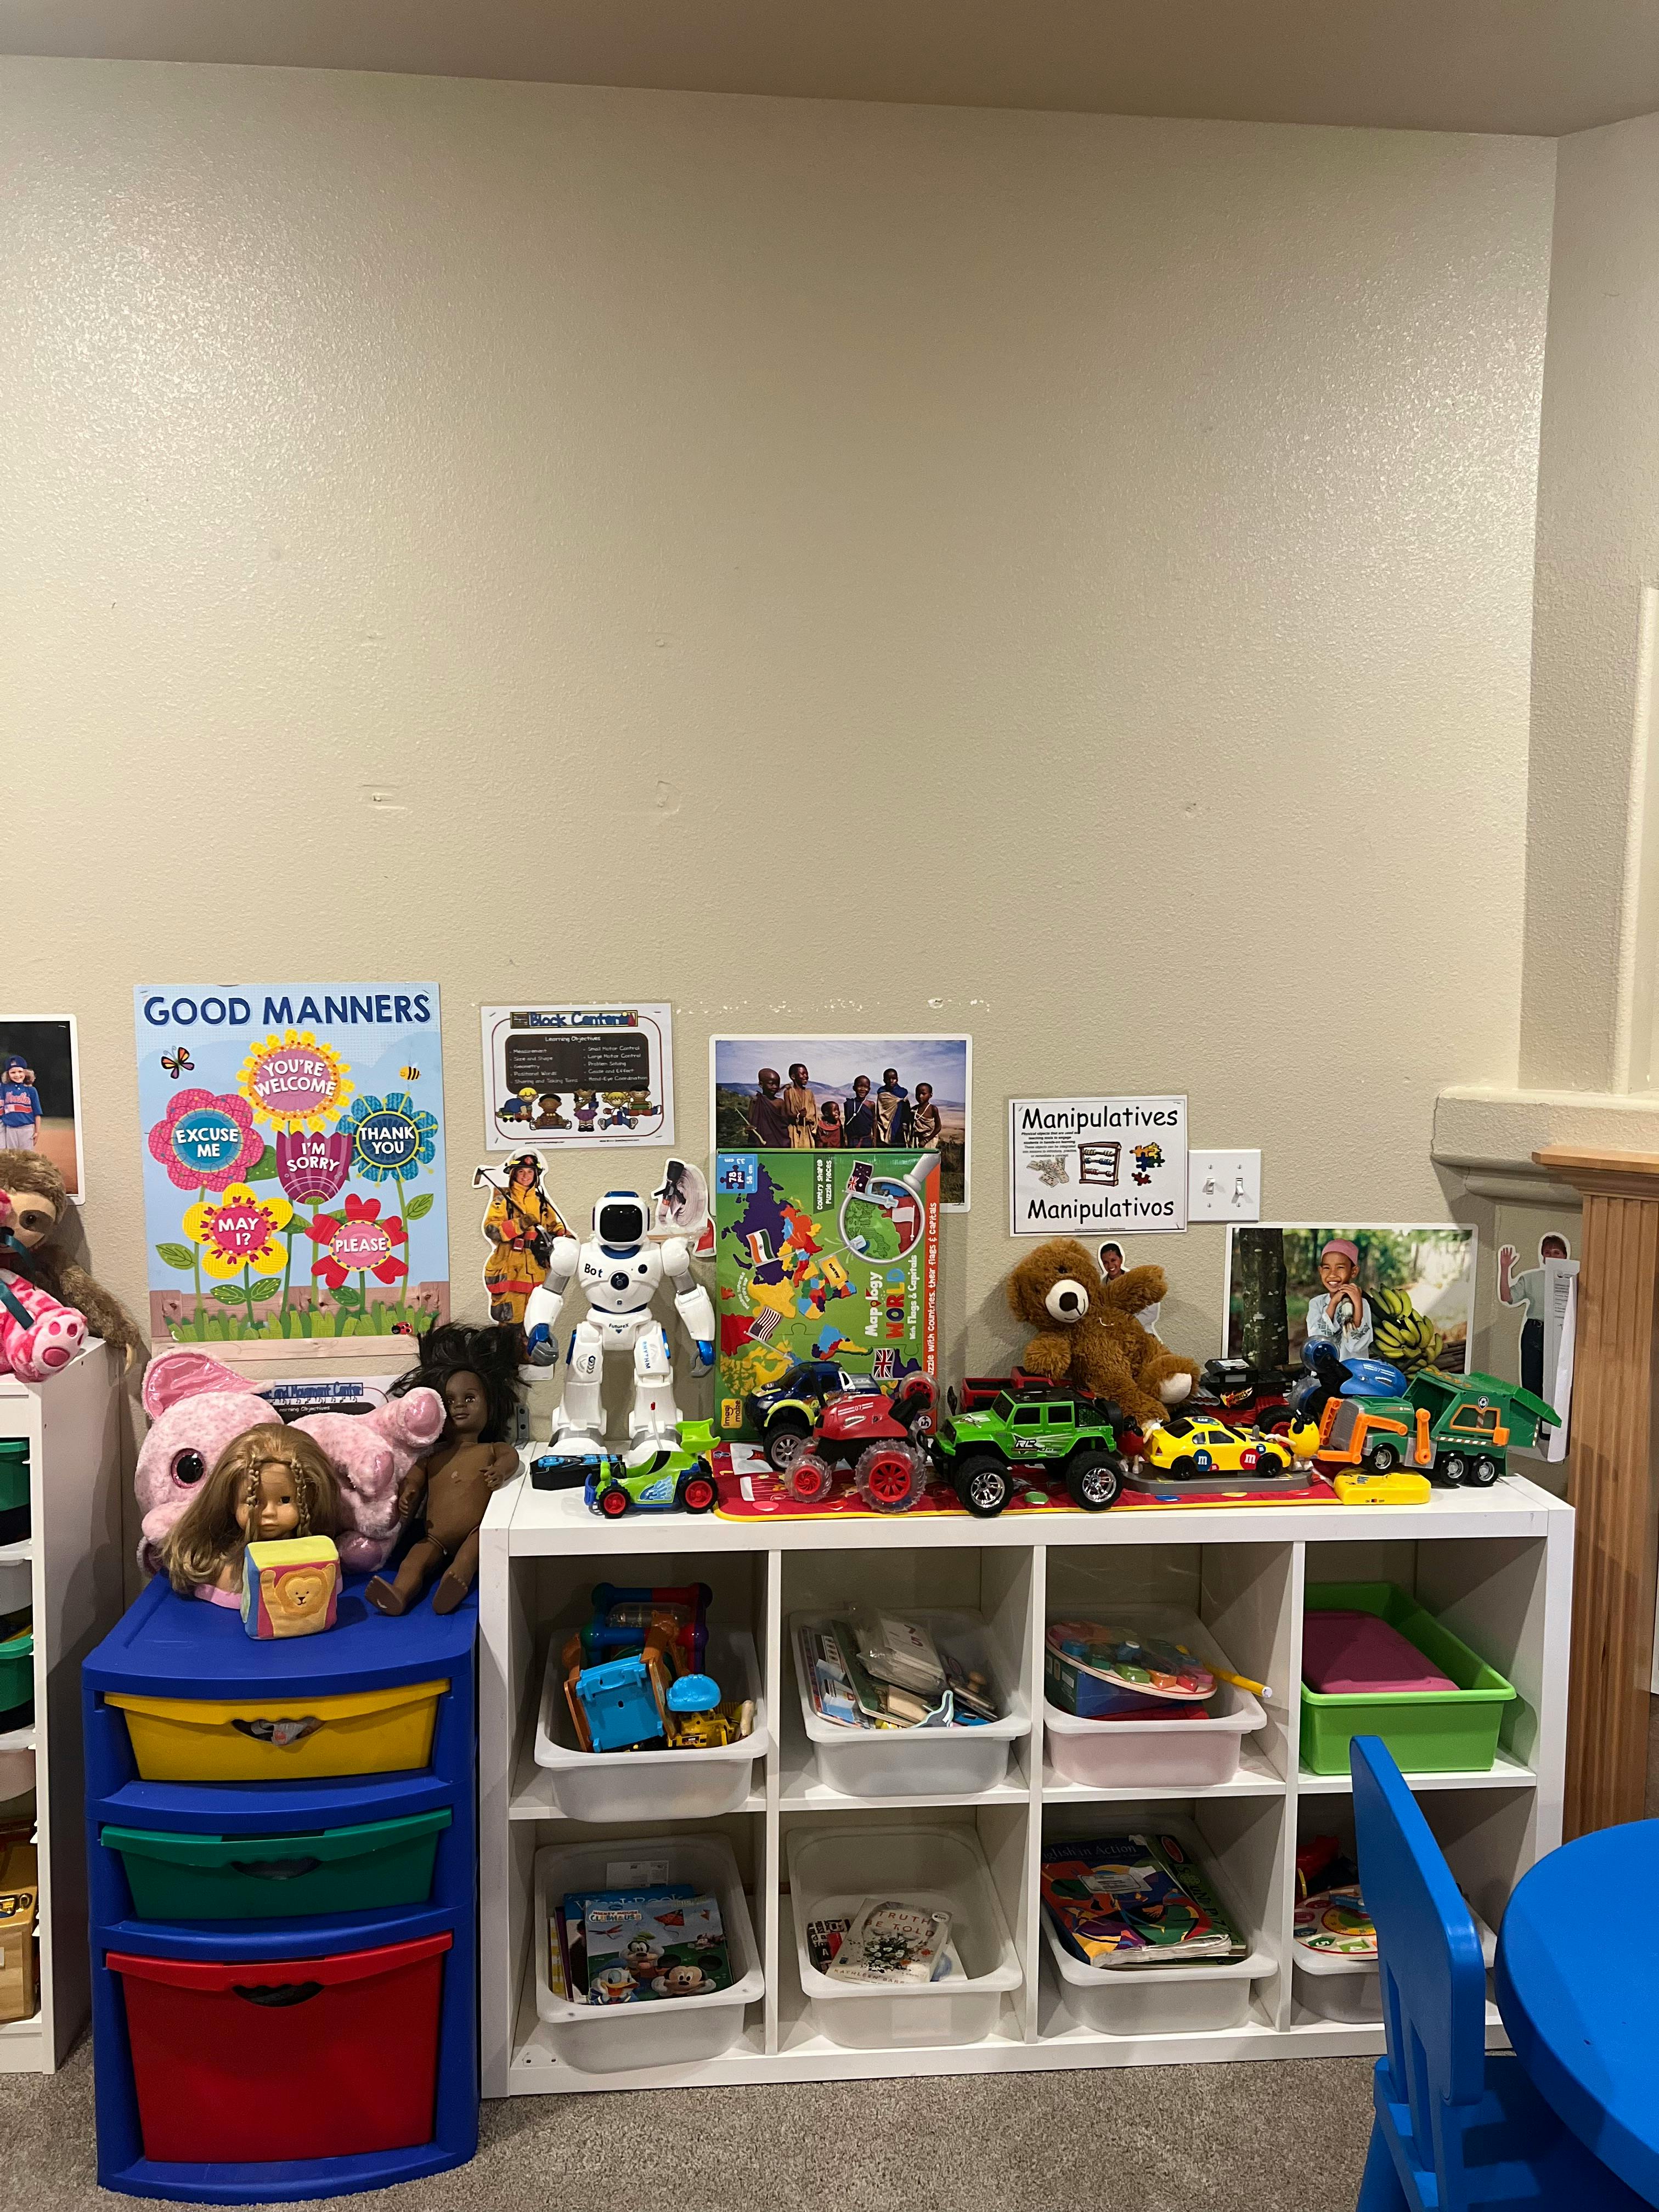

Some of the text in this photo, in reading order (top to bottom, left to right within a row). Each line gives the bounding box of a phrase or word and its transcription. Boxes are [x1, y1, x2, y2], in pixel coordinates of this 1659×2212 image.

[144, 994, 430, 1025] GOOD MANNERS
[530, 1012, 567, 1028] Block
[262, 1059, 325, 1077] YOU'RE
[253, 1076, 337, 1097] WELCOME
[1022, 1105, 1178, 1134] Manipulatives
[176, 1128, 239, 1143] EXCUSE
[359, 1126, 415, 1141] THANK
[198, 1143, 221, 1158] ME
[302, 1143, 325, 1155] I'M
[372, 1141, 404, 1154] YOU
[286, 1156, 340, 1172] SORRY
[729, 1172, 737, 1183] 78
[1028, 1197, 1174, 1224] Manipulativos
[218, 1217, 259, 1232] MAY
[236, 1233, 251, 1245] I?
[336, 1238, 386, 1252] PLEASE
[928, 1244, 936, 1265] flags
[584, 1263, 603, 1278] Bot
[907, 1255, 920, 1291] Capitals
[928, 1267, 936, 1288] their
[865, 1272, 883, 1337] Mapology
[885, 1268, 905, 1339] WORLD
[907, 1301, 919, 1324] Flags
[927, 1333, 935, 1352] with
[274, 1385, 289, 1398] and
[291, 1384, 331, 1398] Movement
[333, 1380, 362, 1397] Center
[723, 1405, 732, 1426] Imagi
[921, 1416, 929, 1427] 5+
[1198, 1455, 1207, 1465] m
[1244, 1454, 1256, 1464] m
[1097, 1844, 1138, 1855] Action
[878, 1910, 932, 1926] TRUTH
[864, 1920, 935, 1937] BE TOLD
[834, 1968, 880, 1980] KATHLEEN
